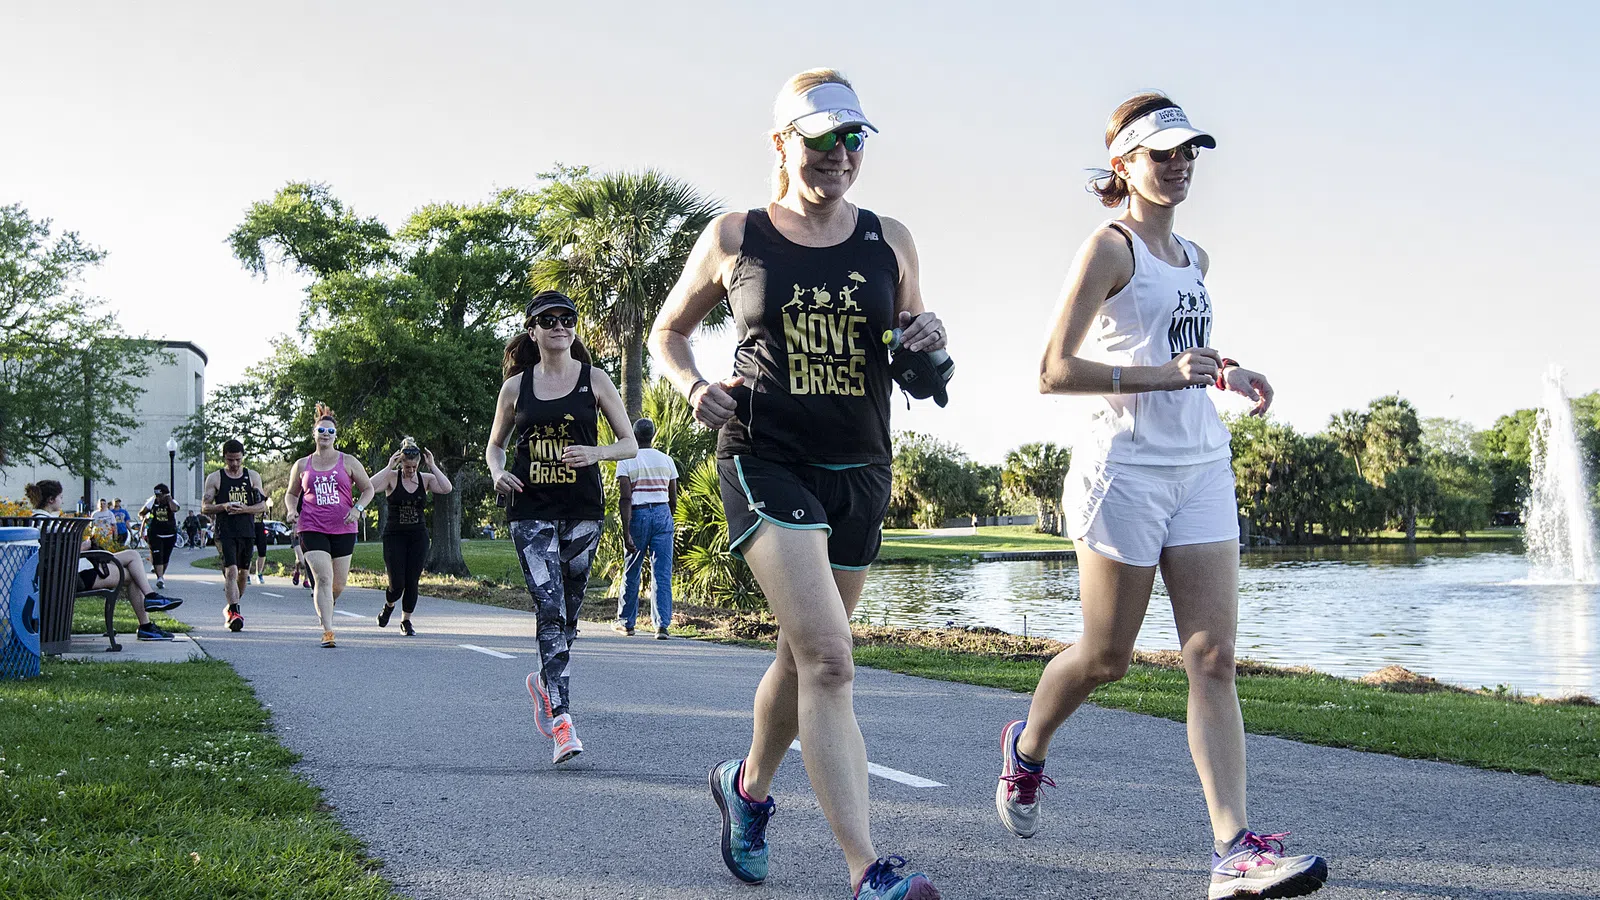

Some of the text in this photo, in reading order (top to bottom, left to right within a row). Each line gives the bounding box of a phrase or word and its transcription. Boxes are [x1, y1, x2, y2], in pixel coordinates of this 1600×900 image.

[782, 312, 867, 355] MOVE
[822, 355, 834, 363] YA
[788, 353, 866, 396] BRASS
[529, 461, 577, 484] BRASS
[313, 482, 339, 495] MOVE
